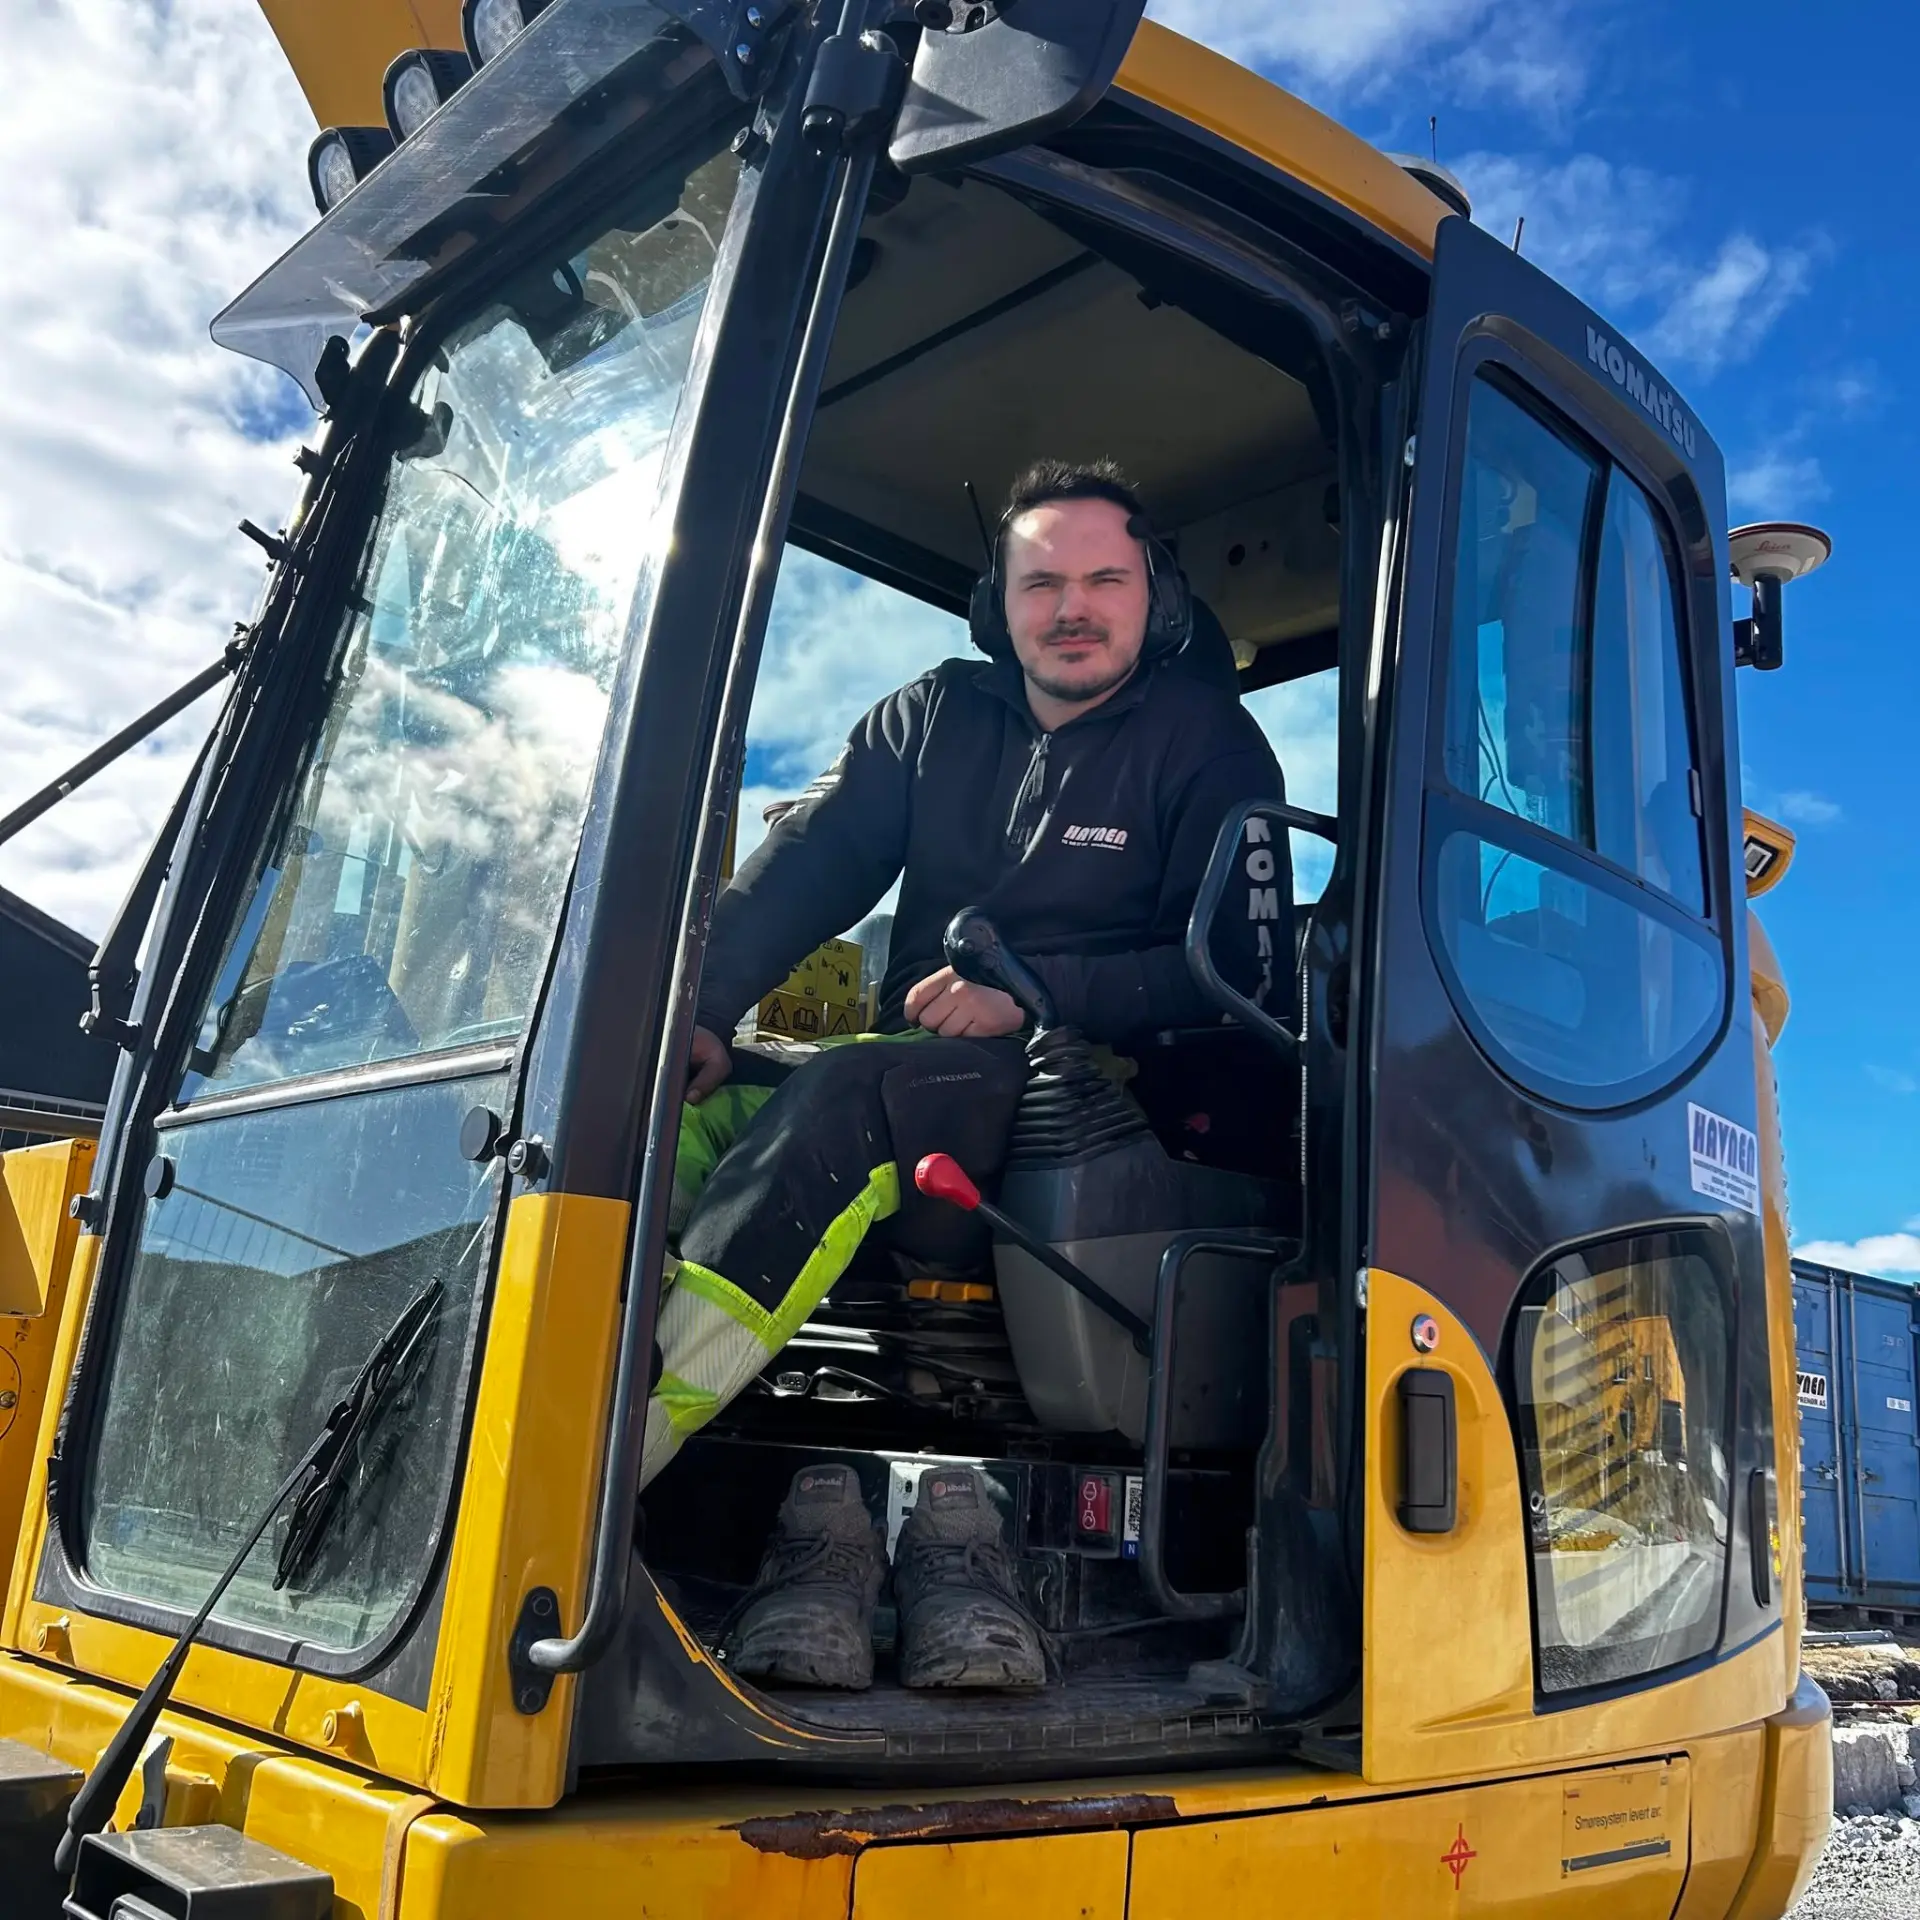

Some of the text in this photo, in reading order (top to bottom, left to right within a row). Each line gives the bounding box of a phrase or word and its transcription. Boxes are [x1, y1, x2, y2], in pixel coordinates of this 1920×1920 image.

[1586, 324, 1696, 460] KOMATSU
[1063, 824, 1129, 845] HAYNEN
[1692, 1110, 1756, 1178] HAYNEN
[1628, 1807, 1650, 1823] levert
